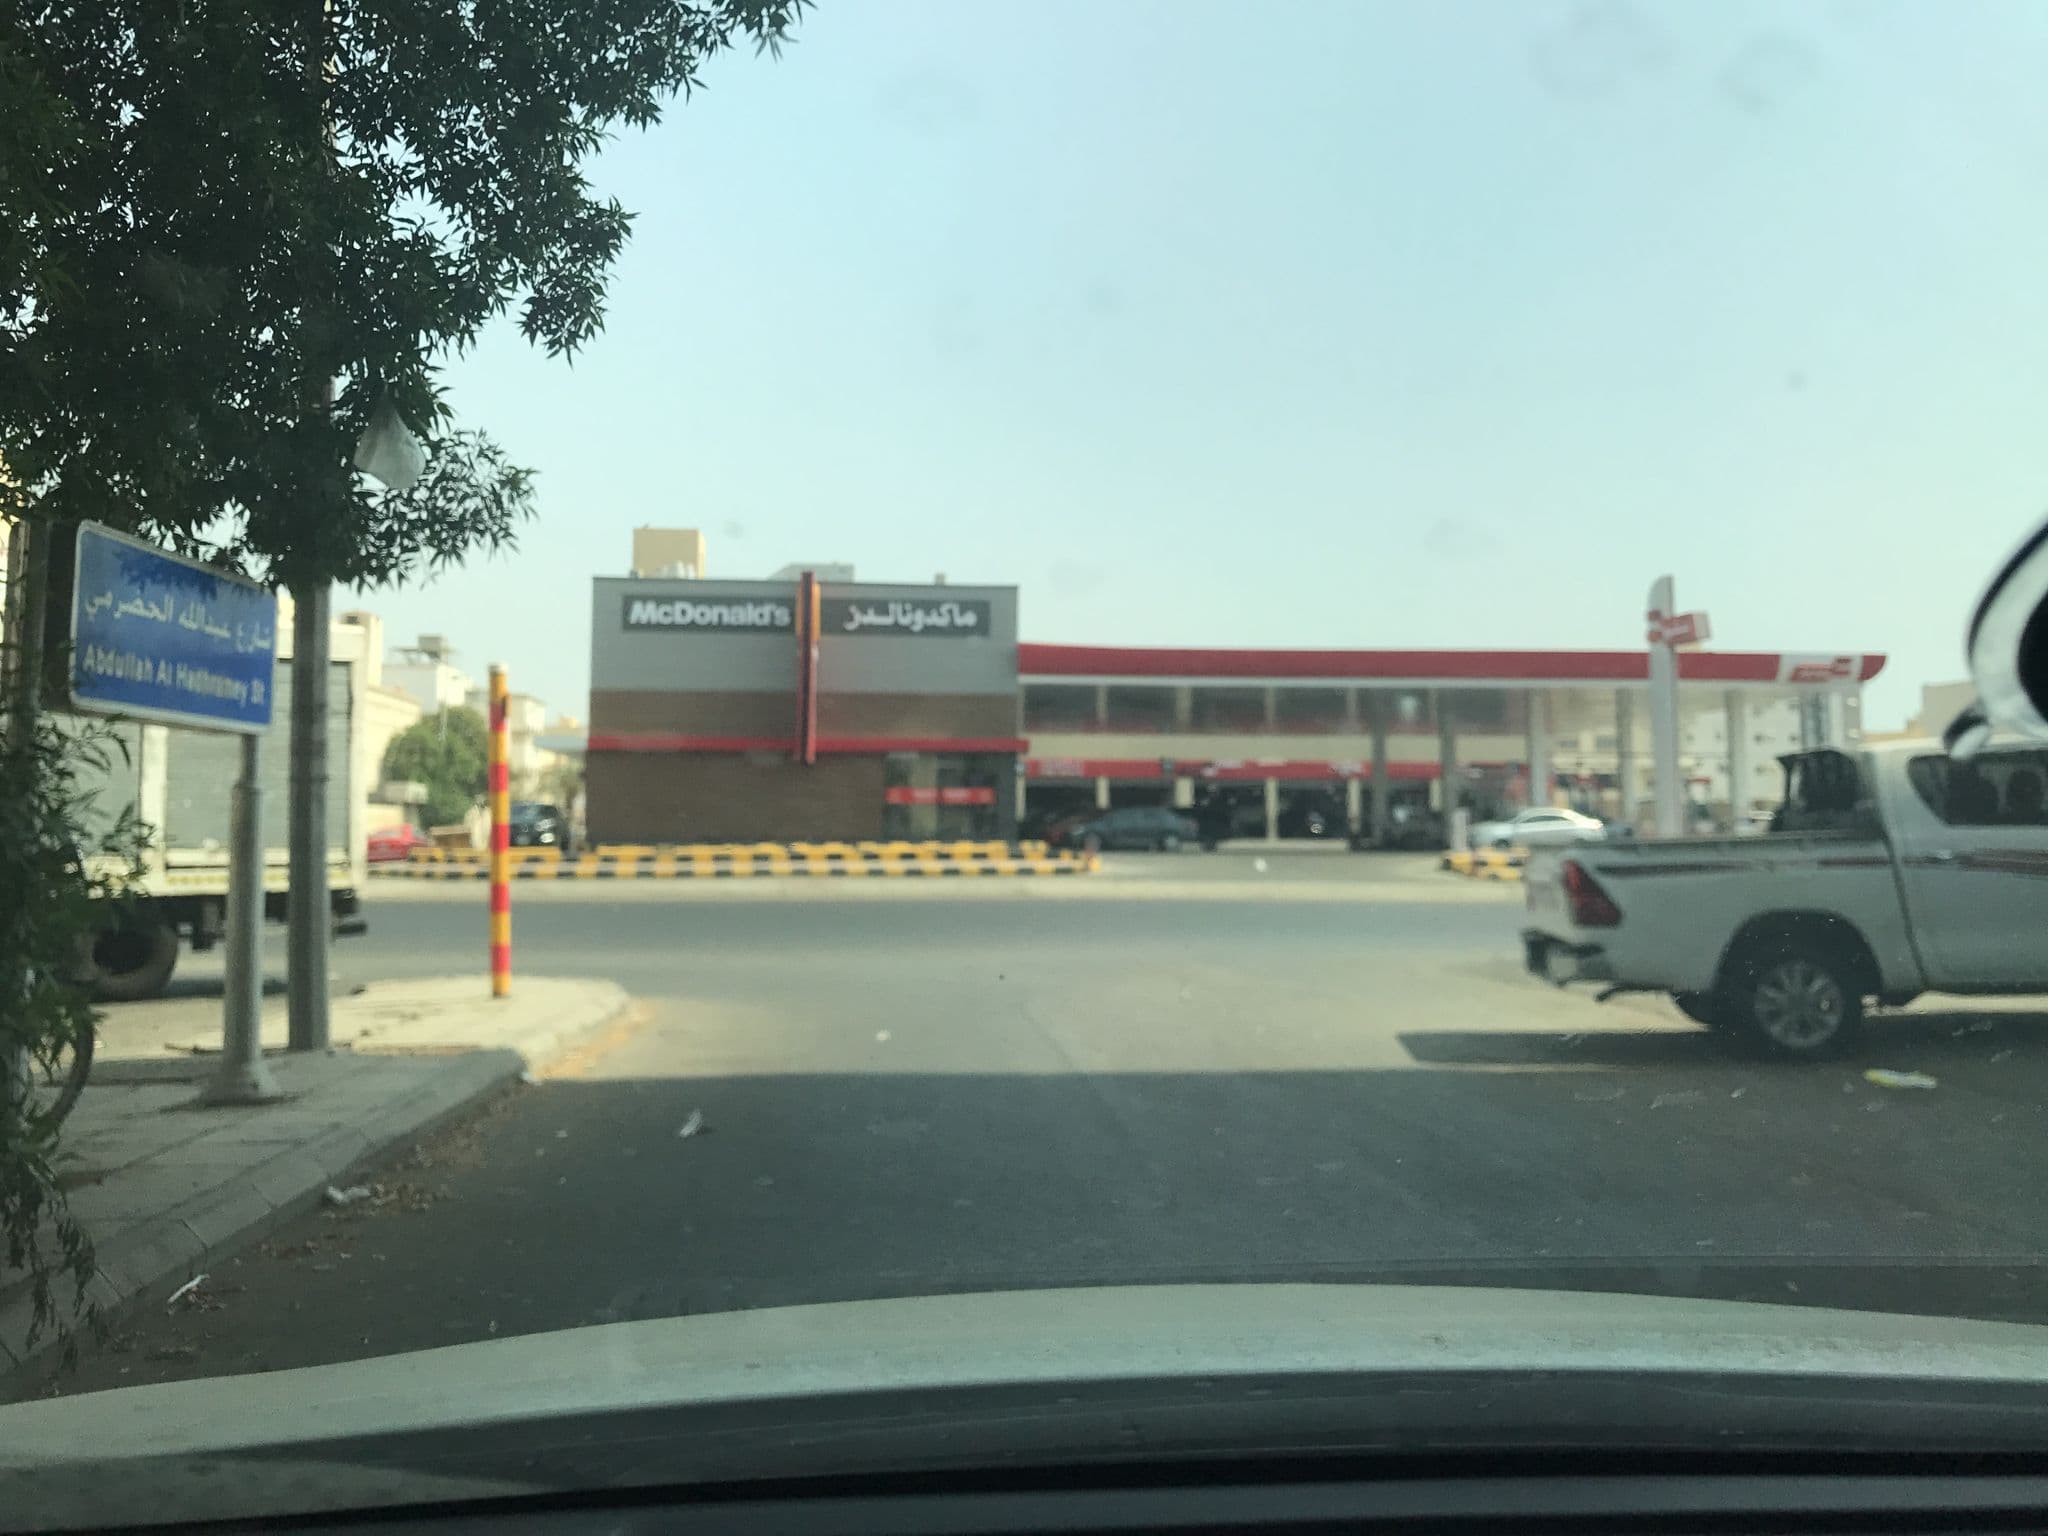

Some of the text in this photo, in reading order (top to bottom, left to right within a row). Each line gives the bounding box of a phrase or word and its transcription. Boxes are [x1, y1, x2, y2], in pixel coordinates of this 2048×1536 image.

[629, 600, 791, 627] McDonald's
[842, 602, 978, 632] ماكدونالدز
[156, 659, 173, 686] Al
